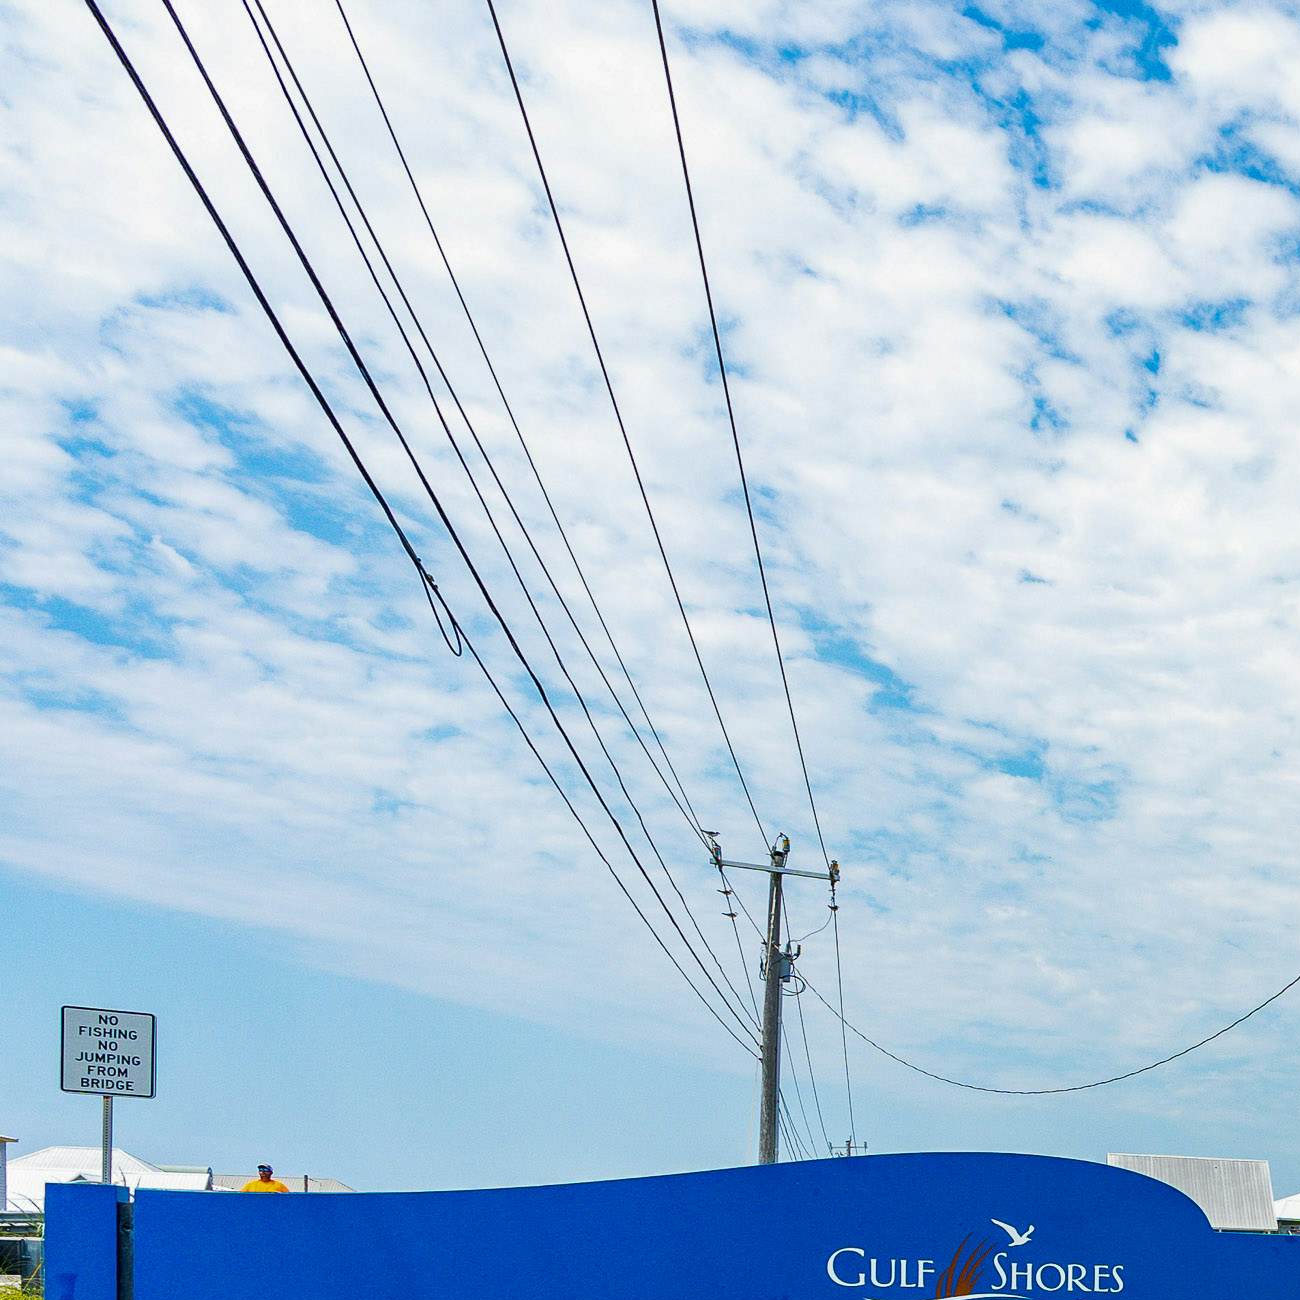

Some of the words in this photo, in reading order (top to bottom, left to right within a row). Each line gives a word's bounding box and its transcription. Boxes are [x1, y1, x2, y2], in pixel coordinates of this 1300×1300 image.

[98, 1014, 119, 1026] NO
[78, 1025, 138, 1040] FISHING
[98, 1040, 118, 1051] NO
[75, 1052, 141, 1066] JUMPING
[87, 1065, 128, 1078] FROM
[80, 1078, 135, 1091] BRIDGE
